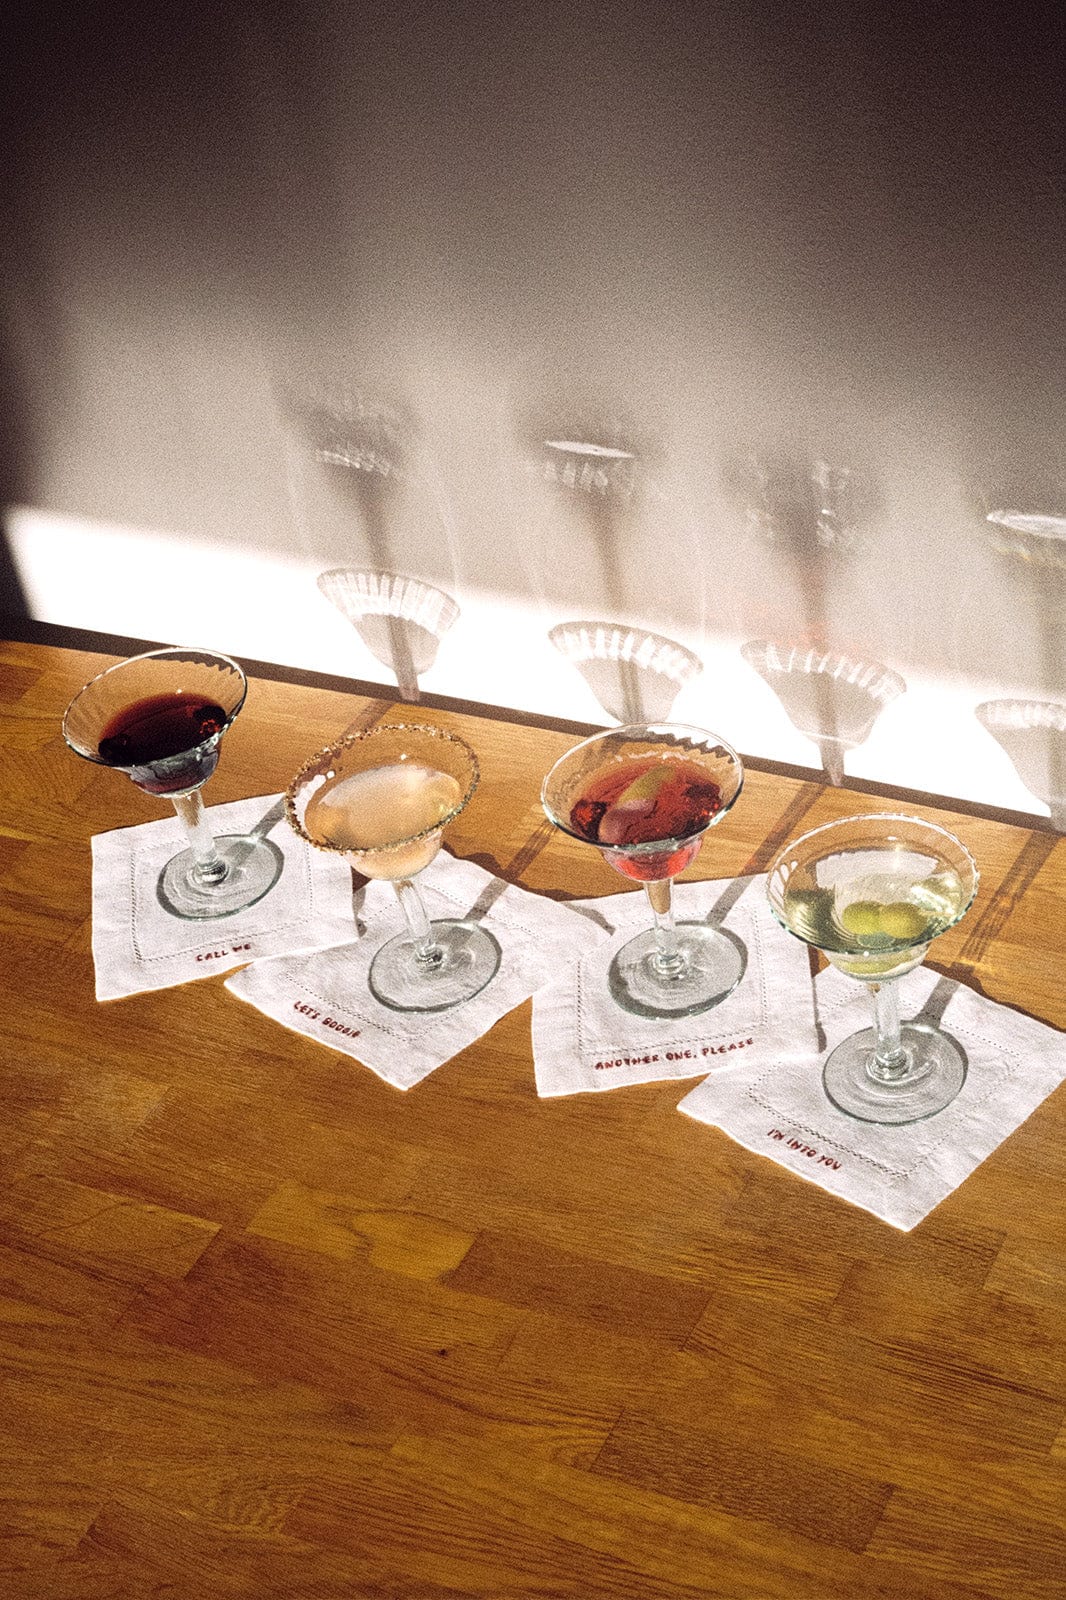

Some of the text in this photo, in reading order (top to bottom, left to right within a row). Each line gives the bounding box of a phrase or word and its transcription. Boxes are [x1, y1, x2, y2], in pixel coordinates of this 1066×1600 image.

[195, 950, 229, 962] CALL
[294, 1001, 361, 1038] LET'S BOOGIE
[594, 1054, 660, 1070] ANOTHER
[702, 1037, 754, 1057] PLEASE
[767, 1128, 842, 1170] I'M INTO YOU
